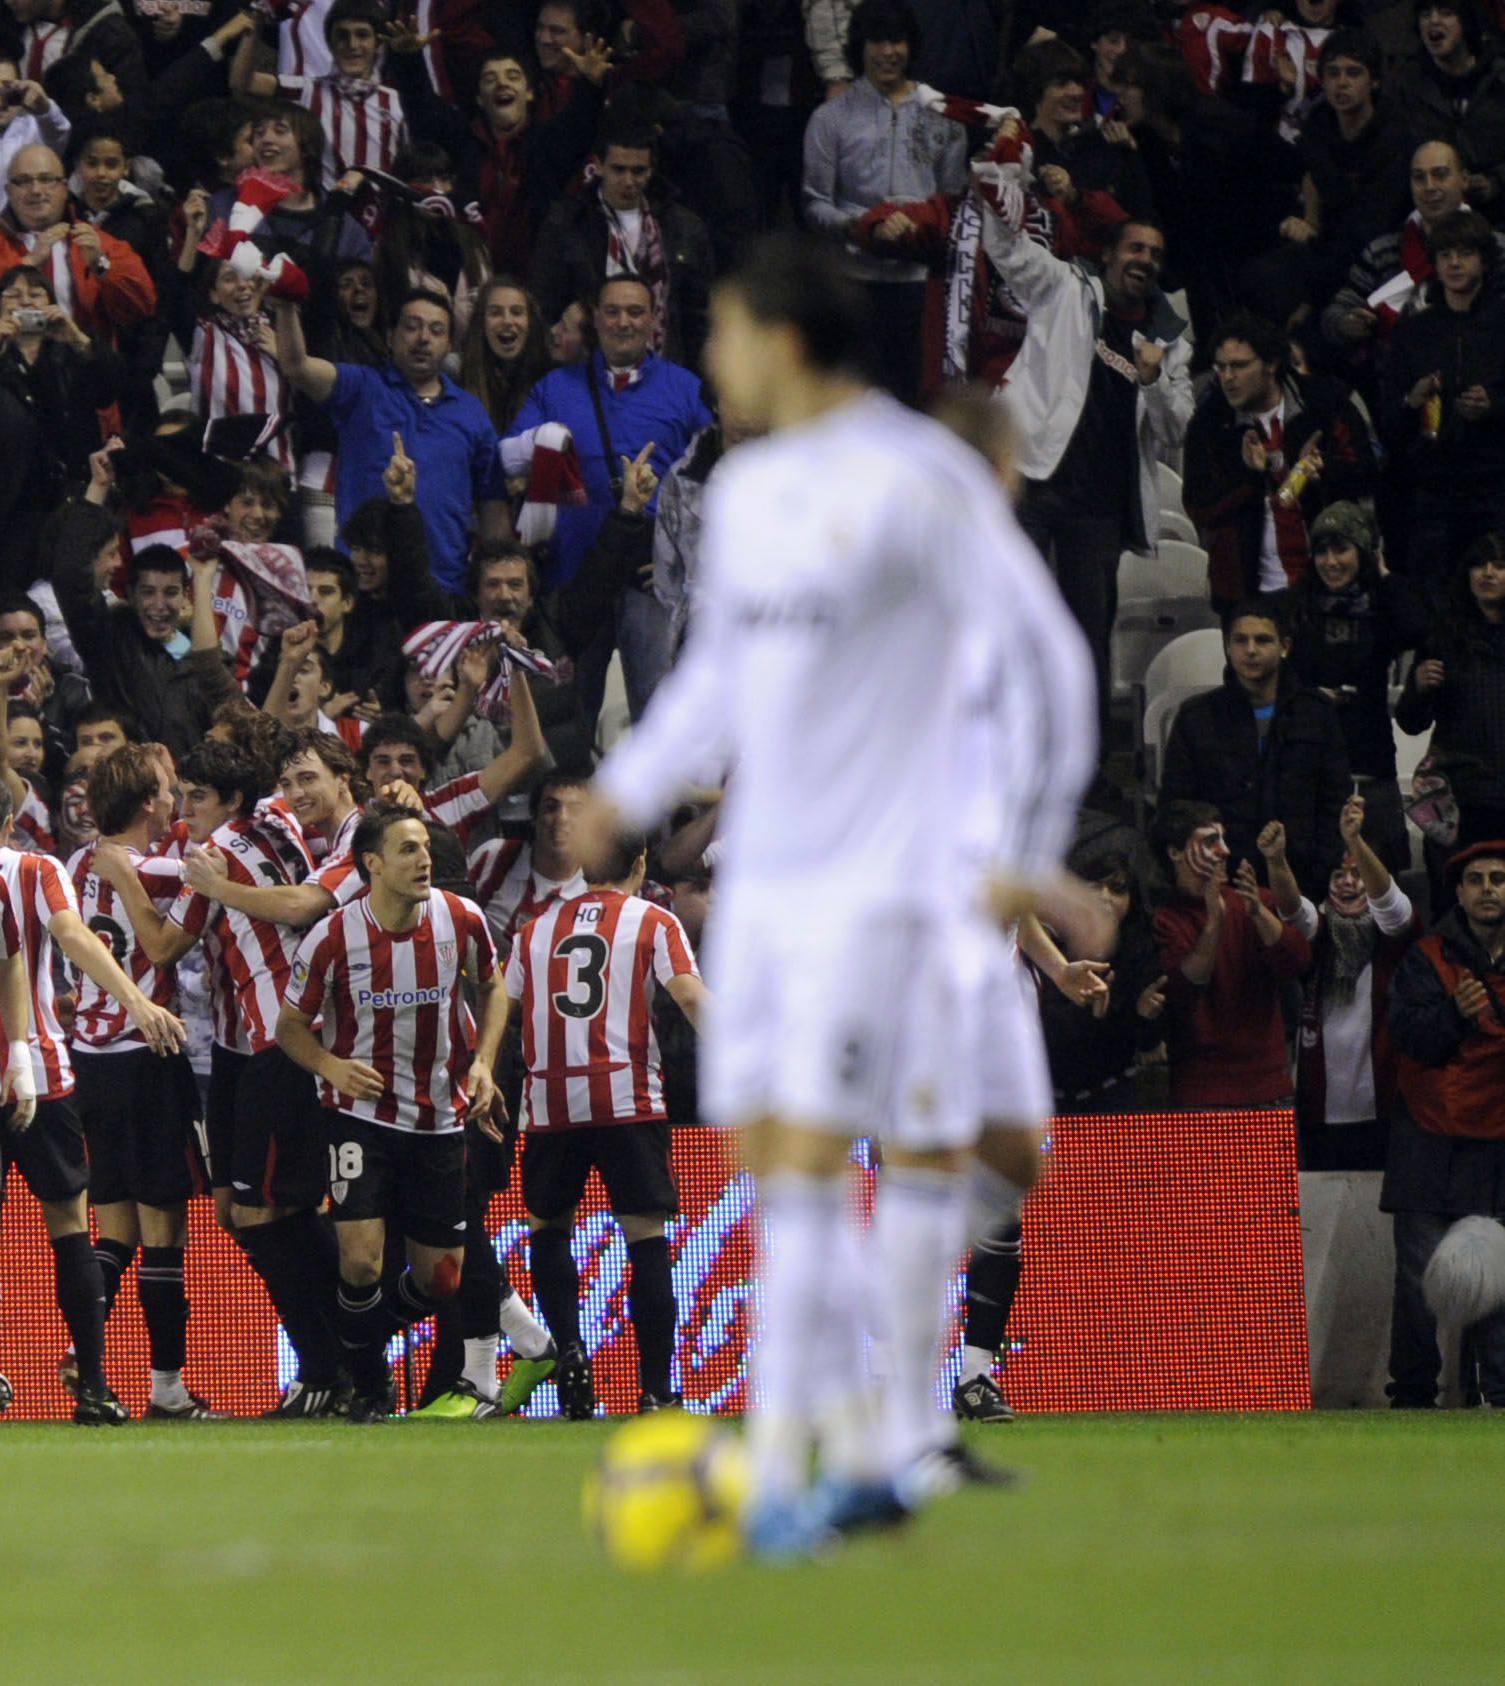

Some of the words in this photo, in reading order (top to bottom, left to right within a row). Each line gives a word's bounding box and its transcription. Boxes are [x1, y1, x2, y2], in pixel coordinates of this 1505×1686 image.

[358, 985, 448, 1007] Petronor
[552, 933, 610, 1020] 3
[328, 1141, 364, 1182] 18
